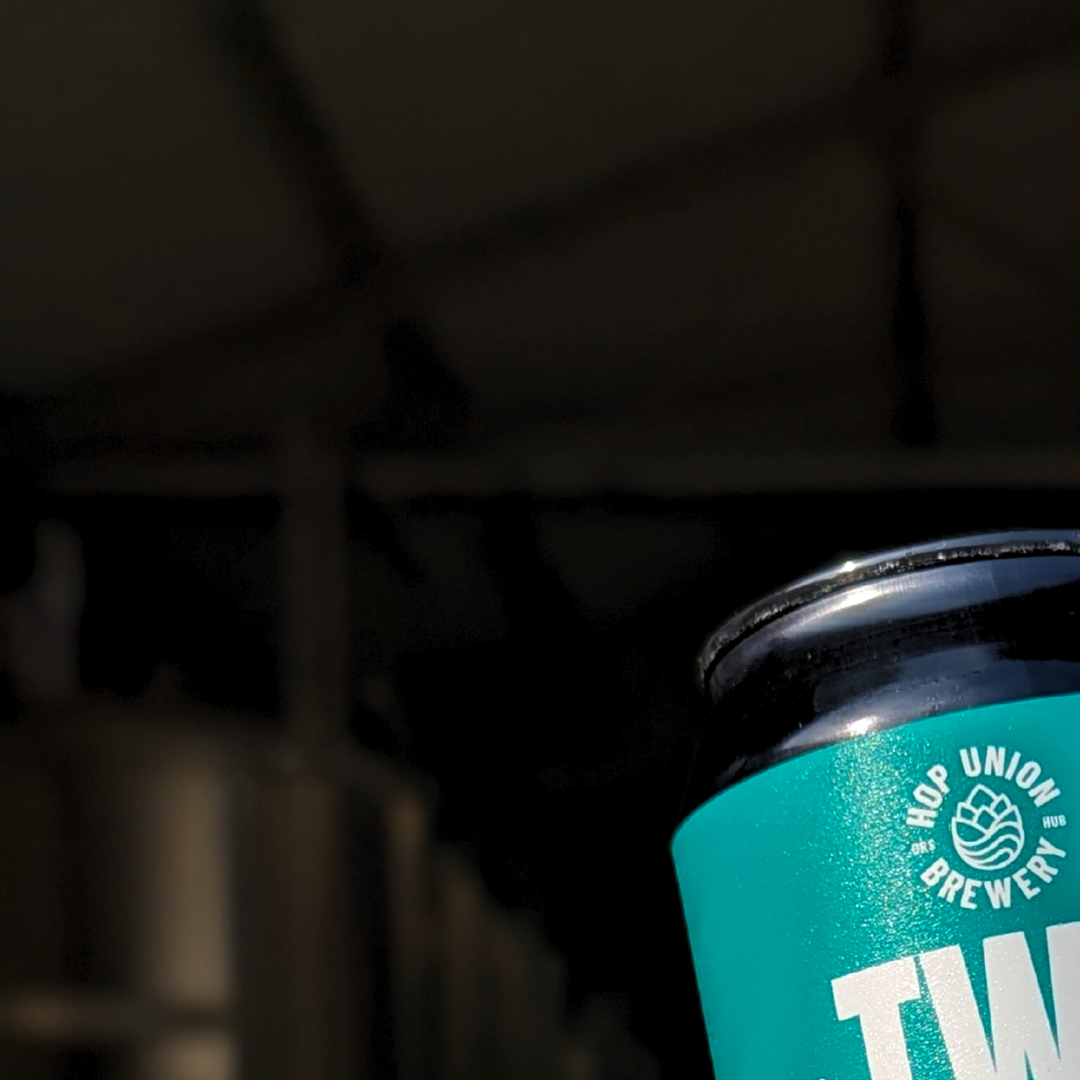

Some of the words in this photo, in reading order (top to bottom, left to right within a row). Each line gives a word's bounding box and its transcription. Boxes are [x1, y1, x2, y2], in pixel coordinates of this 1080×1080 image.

[906, 764, 950, 828] HOP
[959, 745, 1061, 807] UNION
[1042, 814, 1067, 829] HUB
[920, 836, 1067, 910] BREWERY
